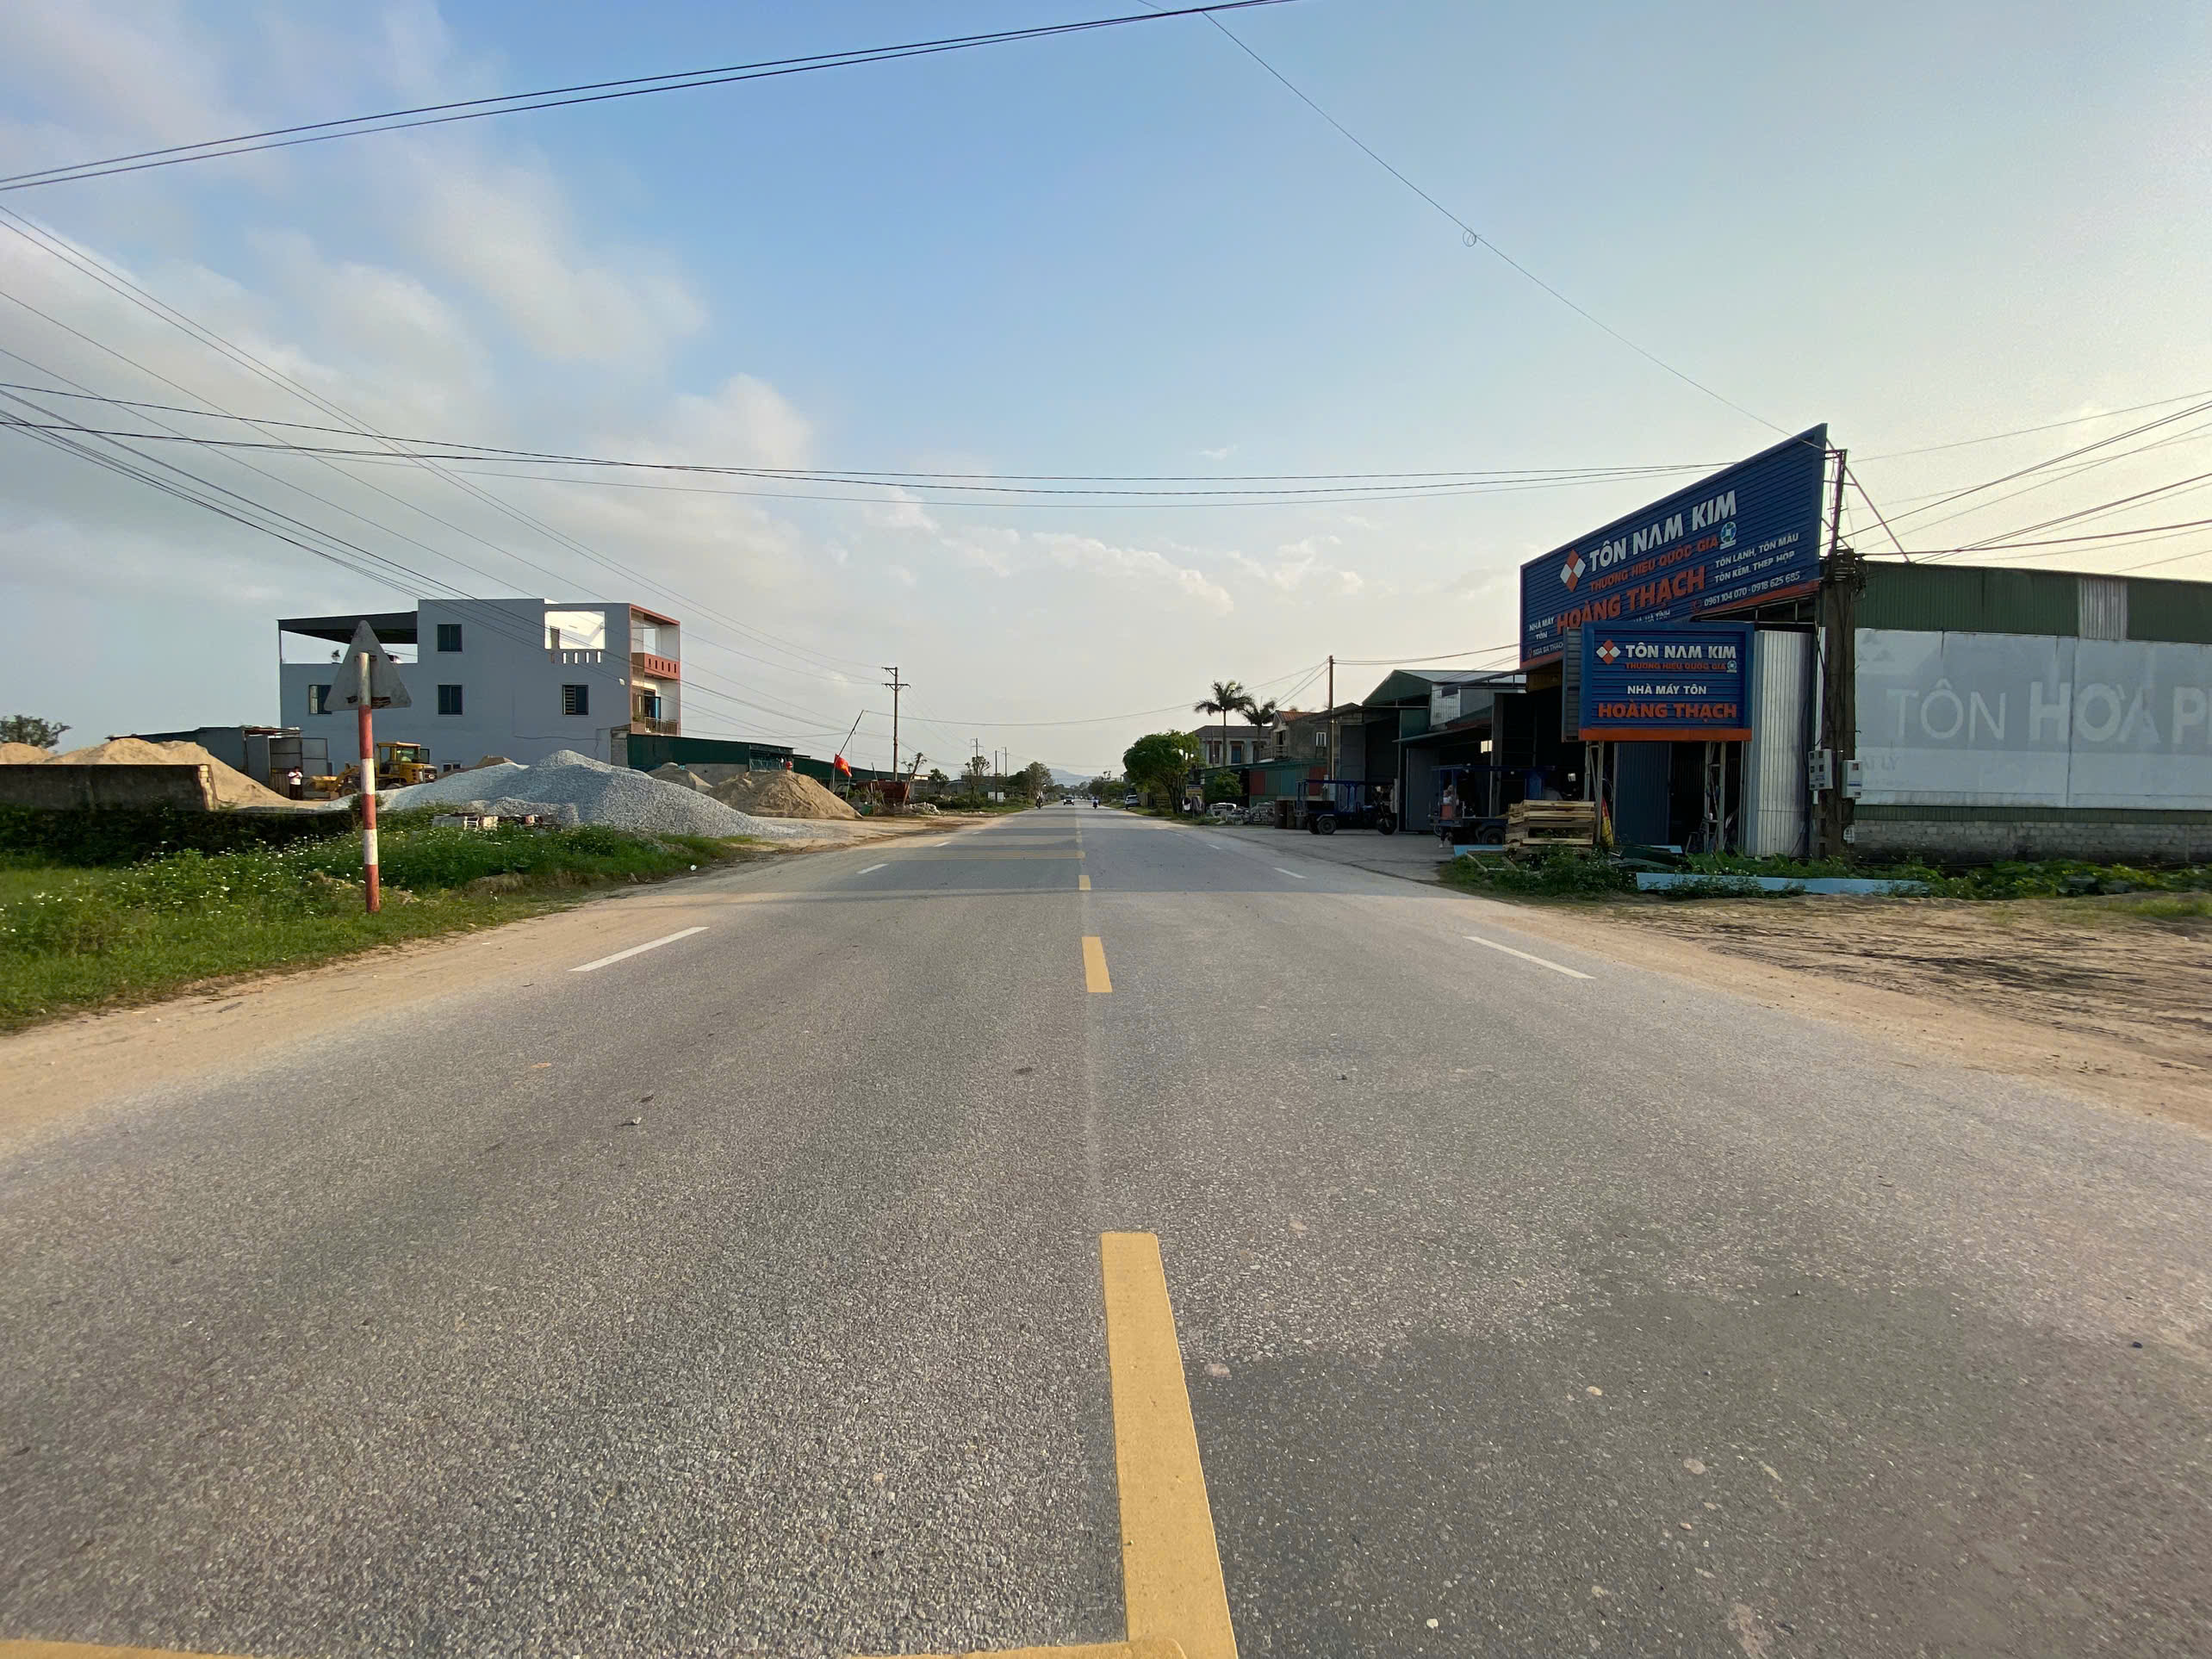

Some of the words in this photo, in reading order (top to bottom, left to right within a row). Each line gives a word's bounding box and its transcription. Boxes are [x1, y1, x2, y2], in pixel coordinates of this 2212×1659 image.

[1589, 537, 1626, 572] TÔN
[1632, 513, 1684, 556] NAM
[1692, 489, 1737, 531] KIM
[1697, 534, 1719, 553] GIA
[1758, 538, 1776, 553] TÔN
[1704, 595, 1720, 606] 0961
[1721, 592, 1733, 602] 104
[1733, 587, 1748, 599] 070
[1751, 581, 1769, 593] 0918
[1769, 575, 1784, 587] 625
[1785, 570, 1801, 583] 685
[1556, 593, 1621, 635] HOÀNG
[1626, 564, 1705, 611] THẠCH
[1529, 619, 1542, 631] NHÀ
[1542, 615, 1555, 627] MÁY
[1625, 642, 1659, 658] TÔN
[1664, 645, 1702, 659] NAM
[1708, 645, 1737, 659] KIM
[1627, 683, 1653, 694] NHÀ
[1656, 683, 1680, 694] MÁY
[1683, 683, 1707, 694] TÔN
[1598, 699, 1668, 718] HOÀNG
[1673, 703, 1737, 723] THẠCH
[1886, 678, 2007, 743] TÔN
[2172, 685, 2212, 746] P
